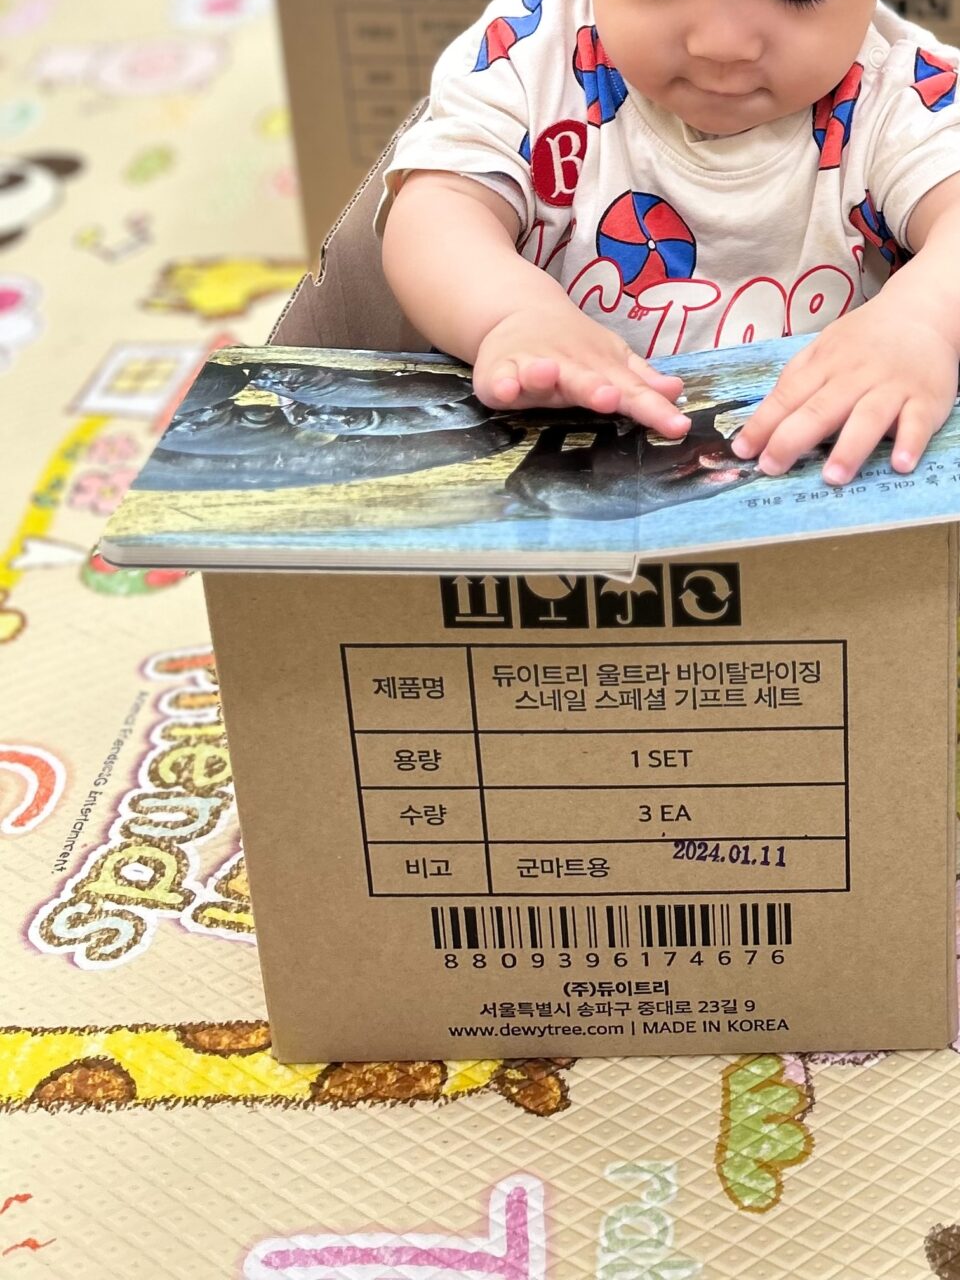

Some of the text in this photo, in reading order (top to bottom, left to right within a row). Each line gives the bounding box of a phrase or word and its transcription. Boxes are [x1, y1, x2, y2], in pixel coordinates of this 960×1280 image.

[492, 660, 820, 687] 듀이트리 울트라 바이탈라이징
[372, 676, 444, 699] 제품명
[515, 686, 803, 712] 스네일 스페셜 기프트 세트
[394, 749, 442, 771] 용량
[631, 750, 693, 768] 1 SET
[400, 804, 447, 826] 수량
[638, 804, 692, 822] 3 EA
[672, 841, 786, 868] 2024.01.11
[405, 857, 452, 879] 비고
[517, 857, 610, 878] 군마트용
[563, 980, 669, 997] (주)듀이트리
[480, 999, 755, 1018] 서울특별시 송파구 중대로 23길 9
[448, 1019, 789, 1038] www.dewytree.com MADE IN KOREA
